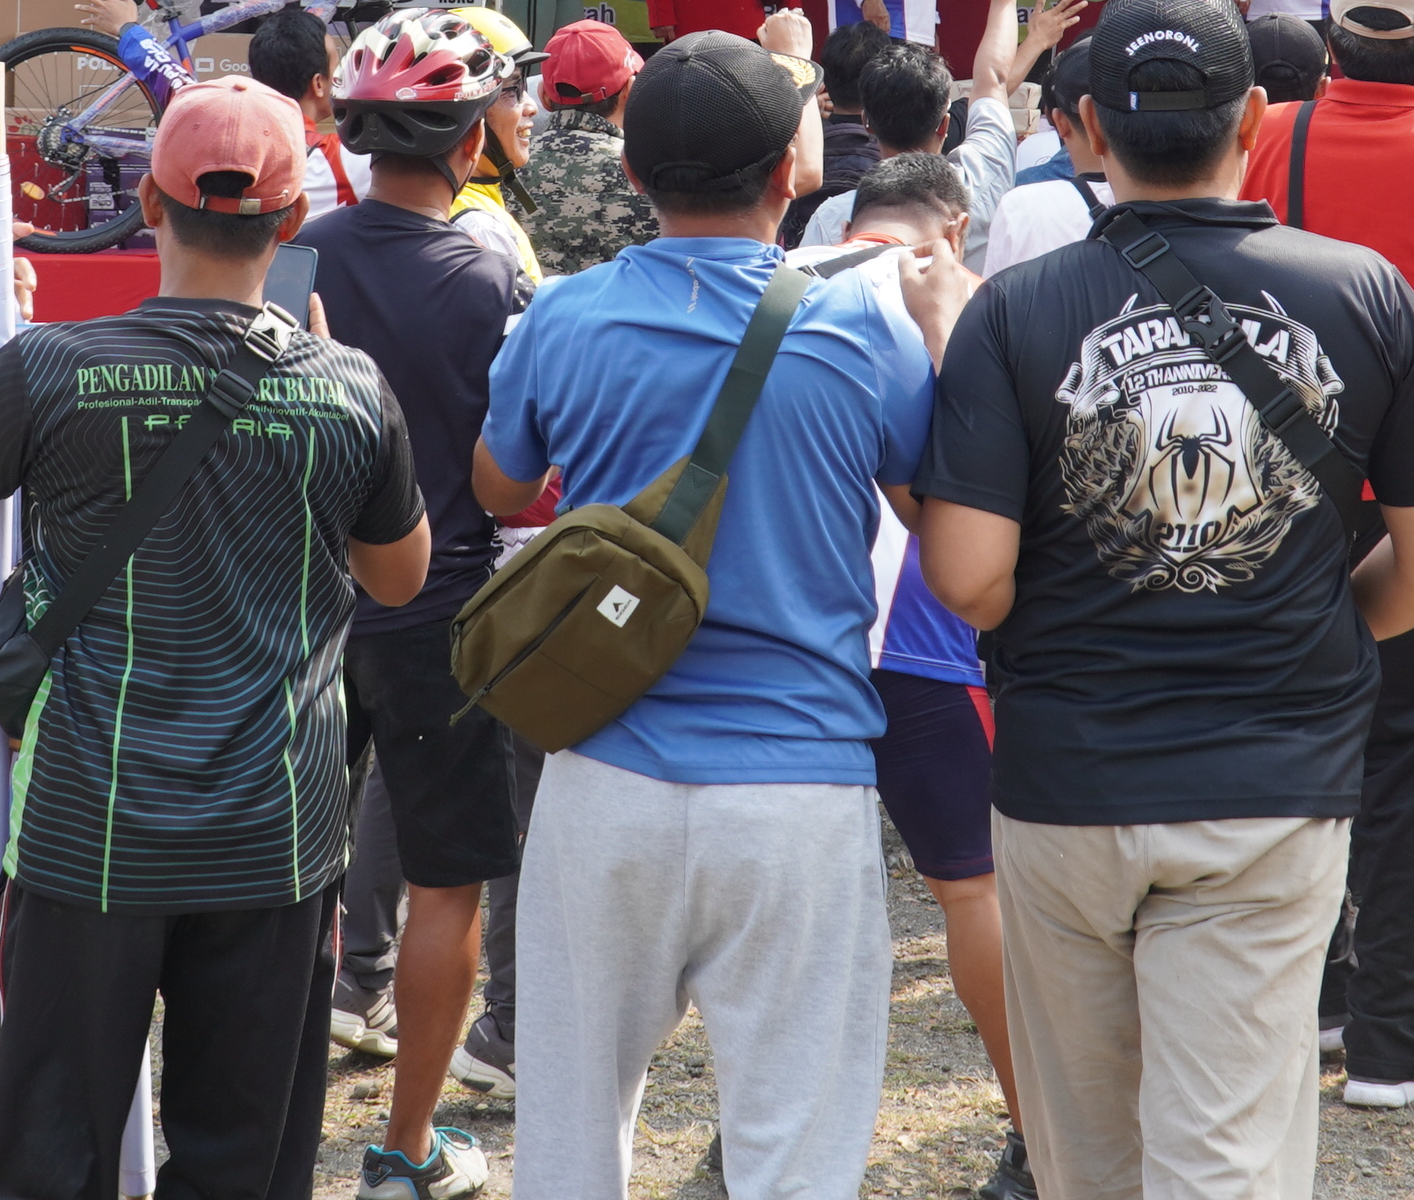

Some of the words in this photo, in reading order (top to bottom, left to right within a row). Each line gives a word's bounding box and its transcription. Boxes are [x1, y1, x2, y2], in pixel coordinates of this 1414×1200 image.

[1125, 29, 1201, 56] JEENORGNL
[77, 363, 206, 396] PENGADILAN
[286, 376, 349, 408] BLITAR
[1171, 384, 1218, 396] 2010-2022
